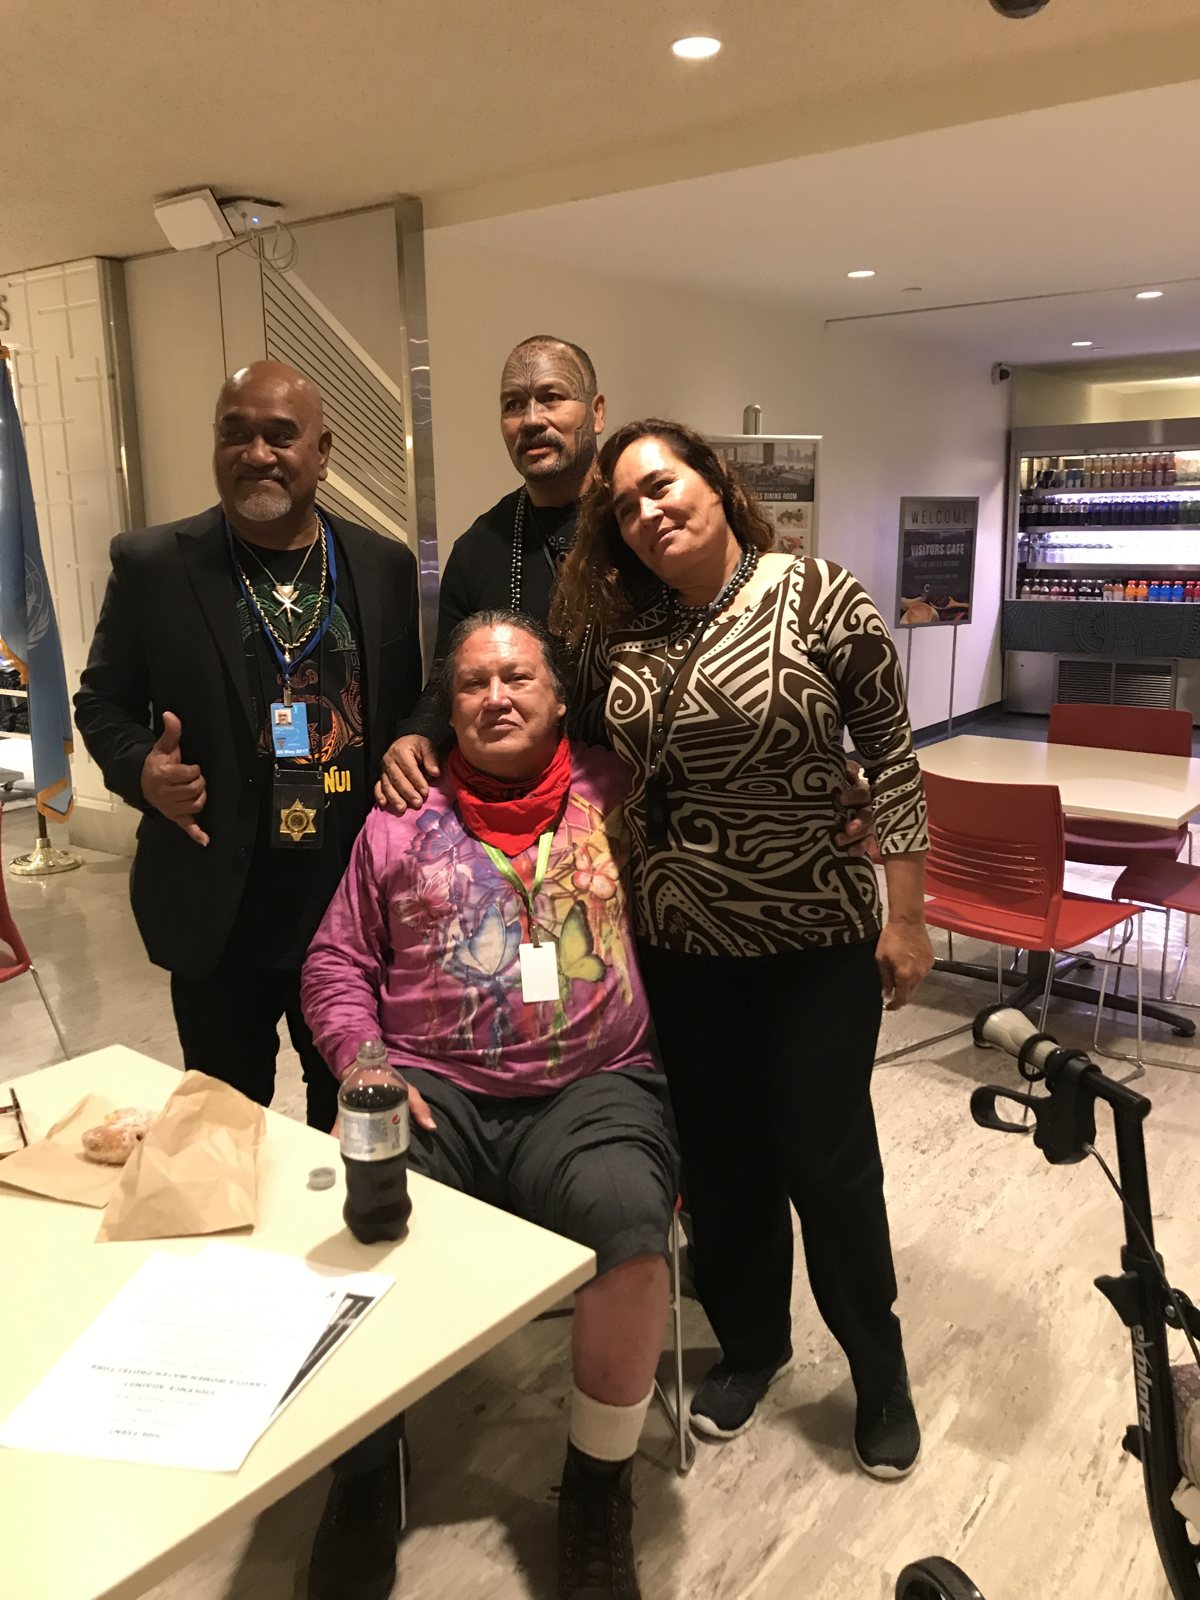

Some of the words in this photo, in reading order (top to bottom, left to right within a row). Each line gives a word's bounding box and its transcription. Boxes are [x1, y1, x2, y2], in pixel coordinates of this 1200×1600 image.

[763, 492, 782, 500] DINING
[782, 492, 798, 500] ROOM
[911, 509, 969, 524] WELCOME
[911, 543, 945, 556] VISITORS
[946, 543, 965, 555] CAFE
[1132, 1324, 1154, 1432] explore
